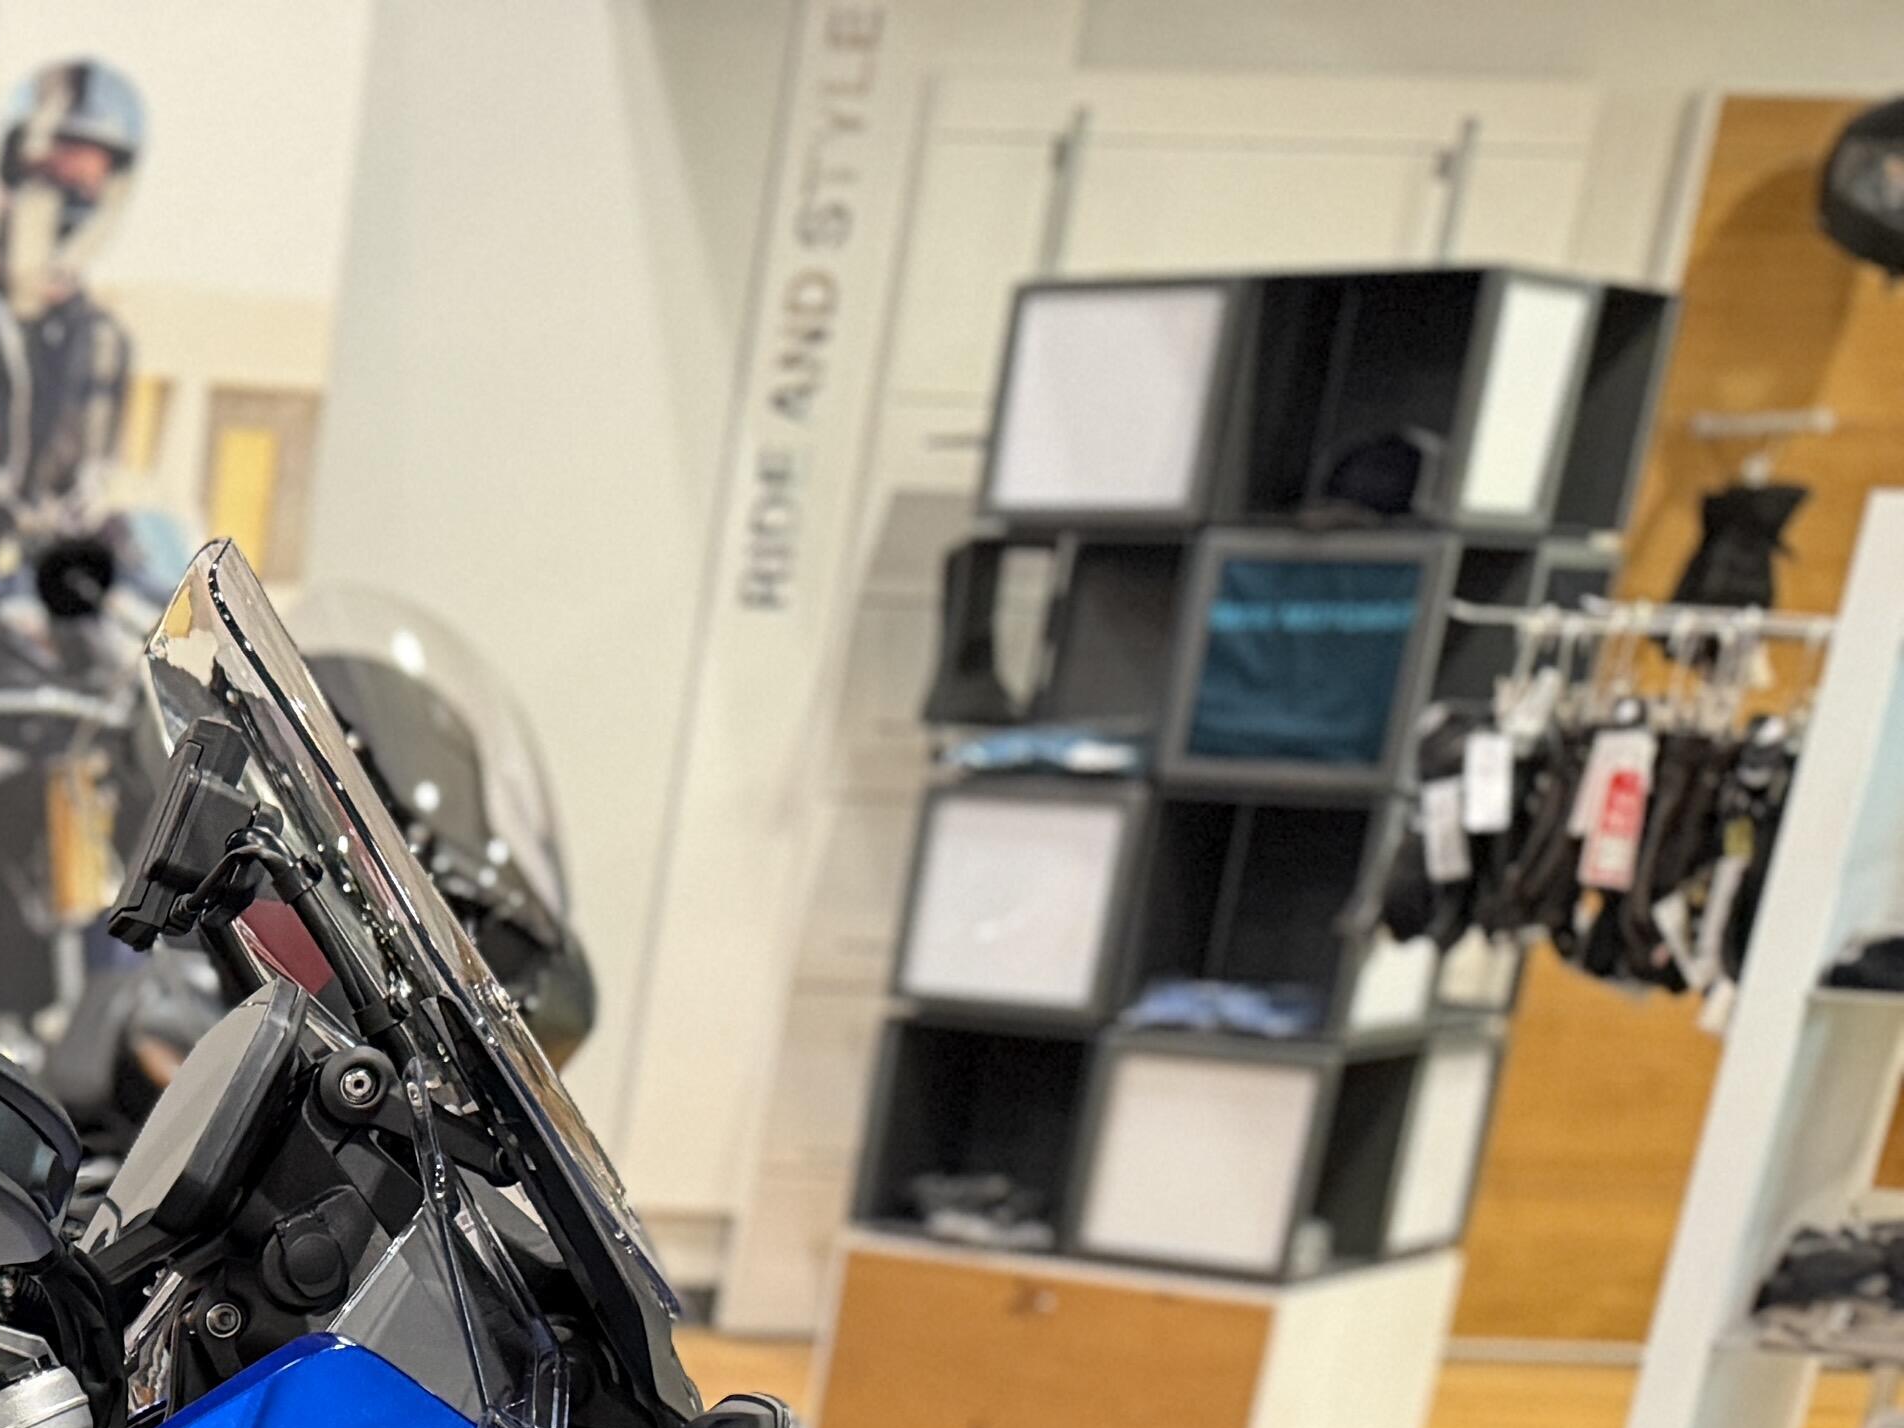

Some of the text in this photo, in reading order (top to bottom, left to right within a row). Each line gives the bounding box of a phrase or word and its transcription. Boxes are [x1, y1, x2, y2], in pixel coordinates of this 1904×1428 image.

[737, 6, 887, 612] RIDE AND STYLE
